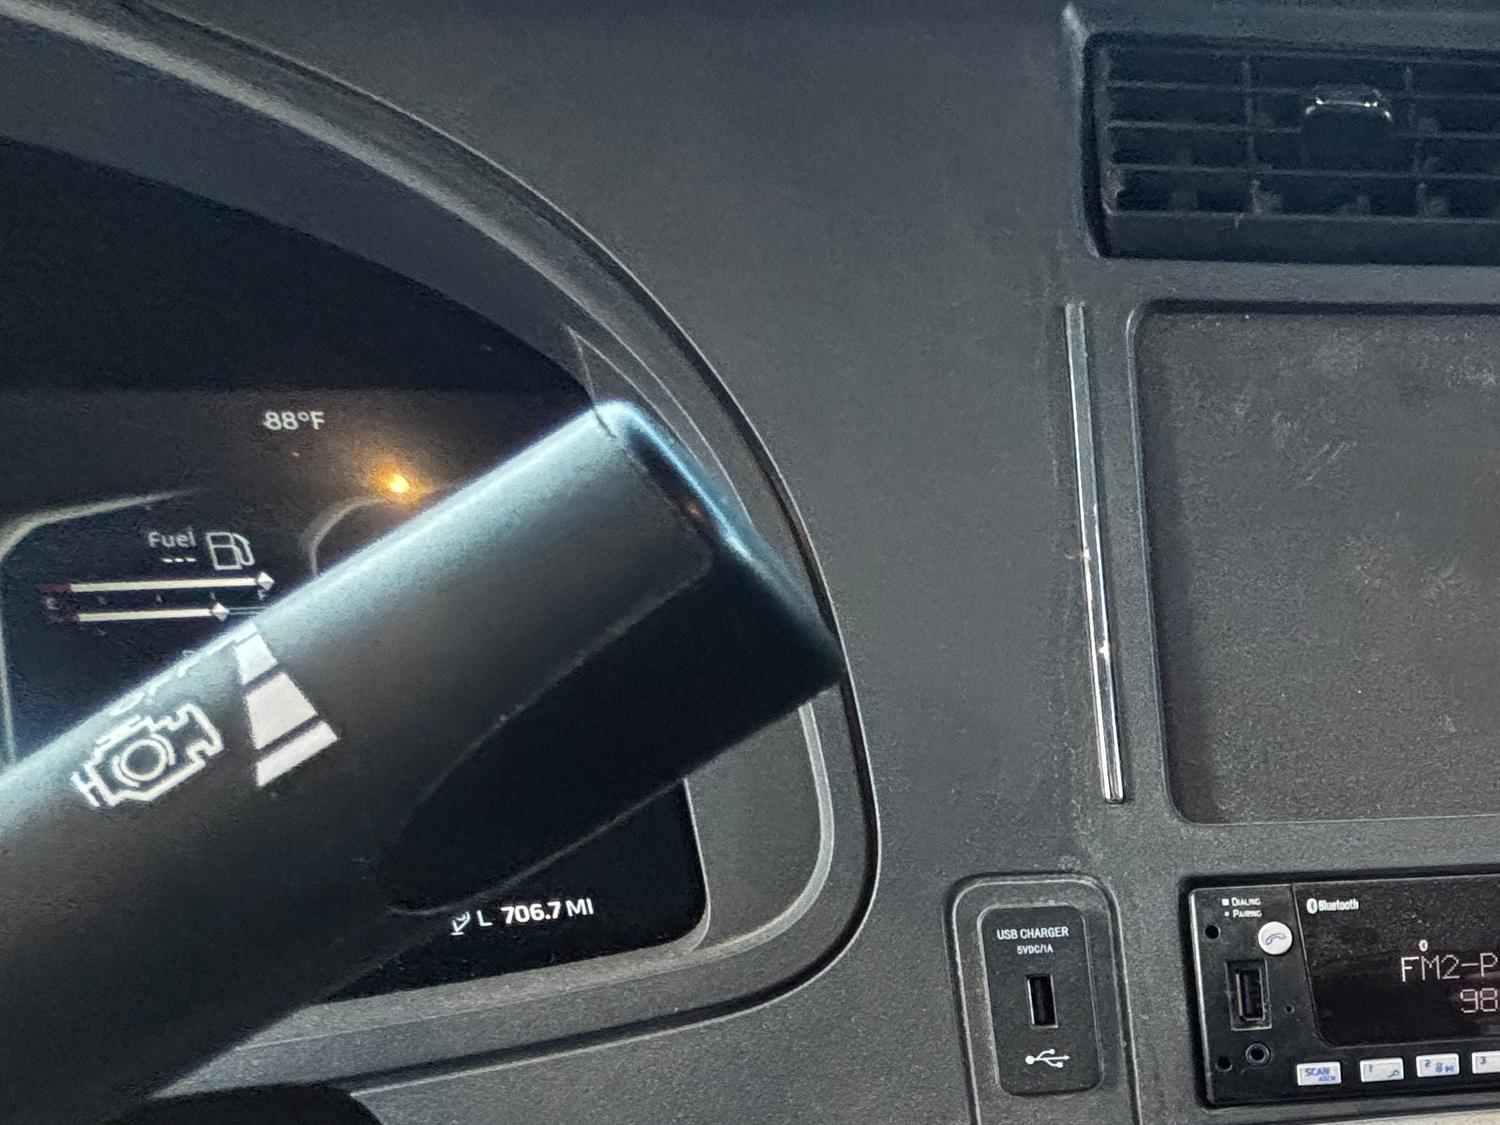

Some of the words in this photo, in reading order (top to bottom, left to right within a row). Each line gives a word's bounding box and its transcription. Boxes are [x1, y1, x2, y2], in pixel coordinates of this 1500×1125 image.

[263, 411, 326, 431] 88°F
[148, 527, 197, 548] Fuel
[500, 900, 562, 925] 706.7
[565, 898, 594, 917] MI
[1318, 898, 1360, 912] Bluetooth
[997, 928, 1018, 941] USB
[1020, 926, 1070, 939] CHARGER
[1305, 1066, 1330, 1078] SCAN
